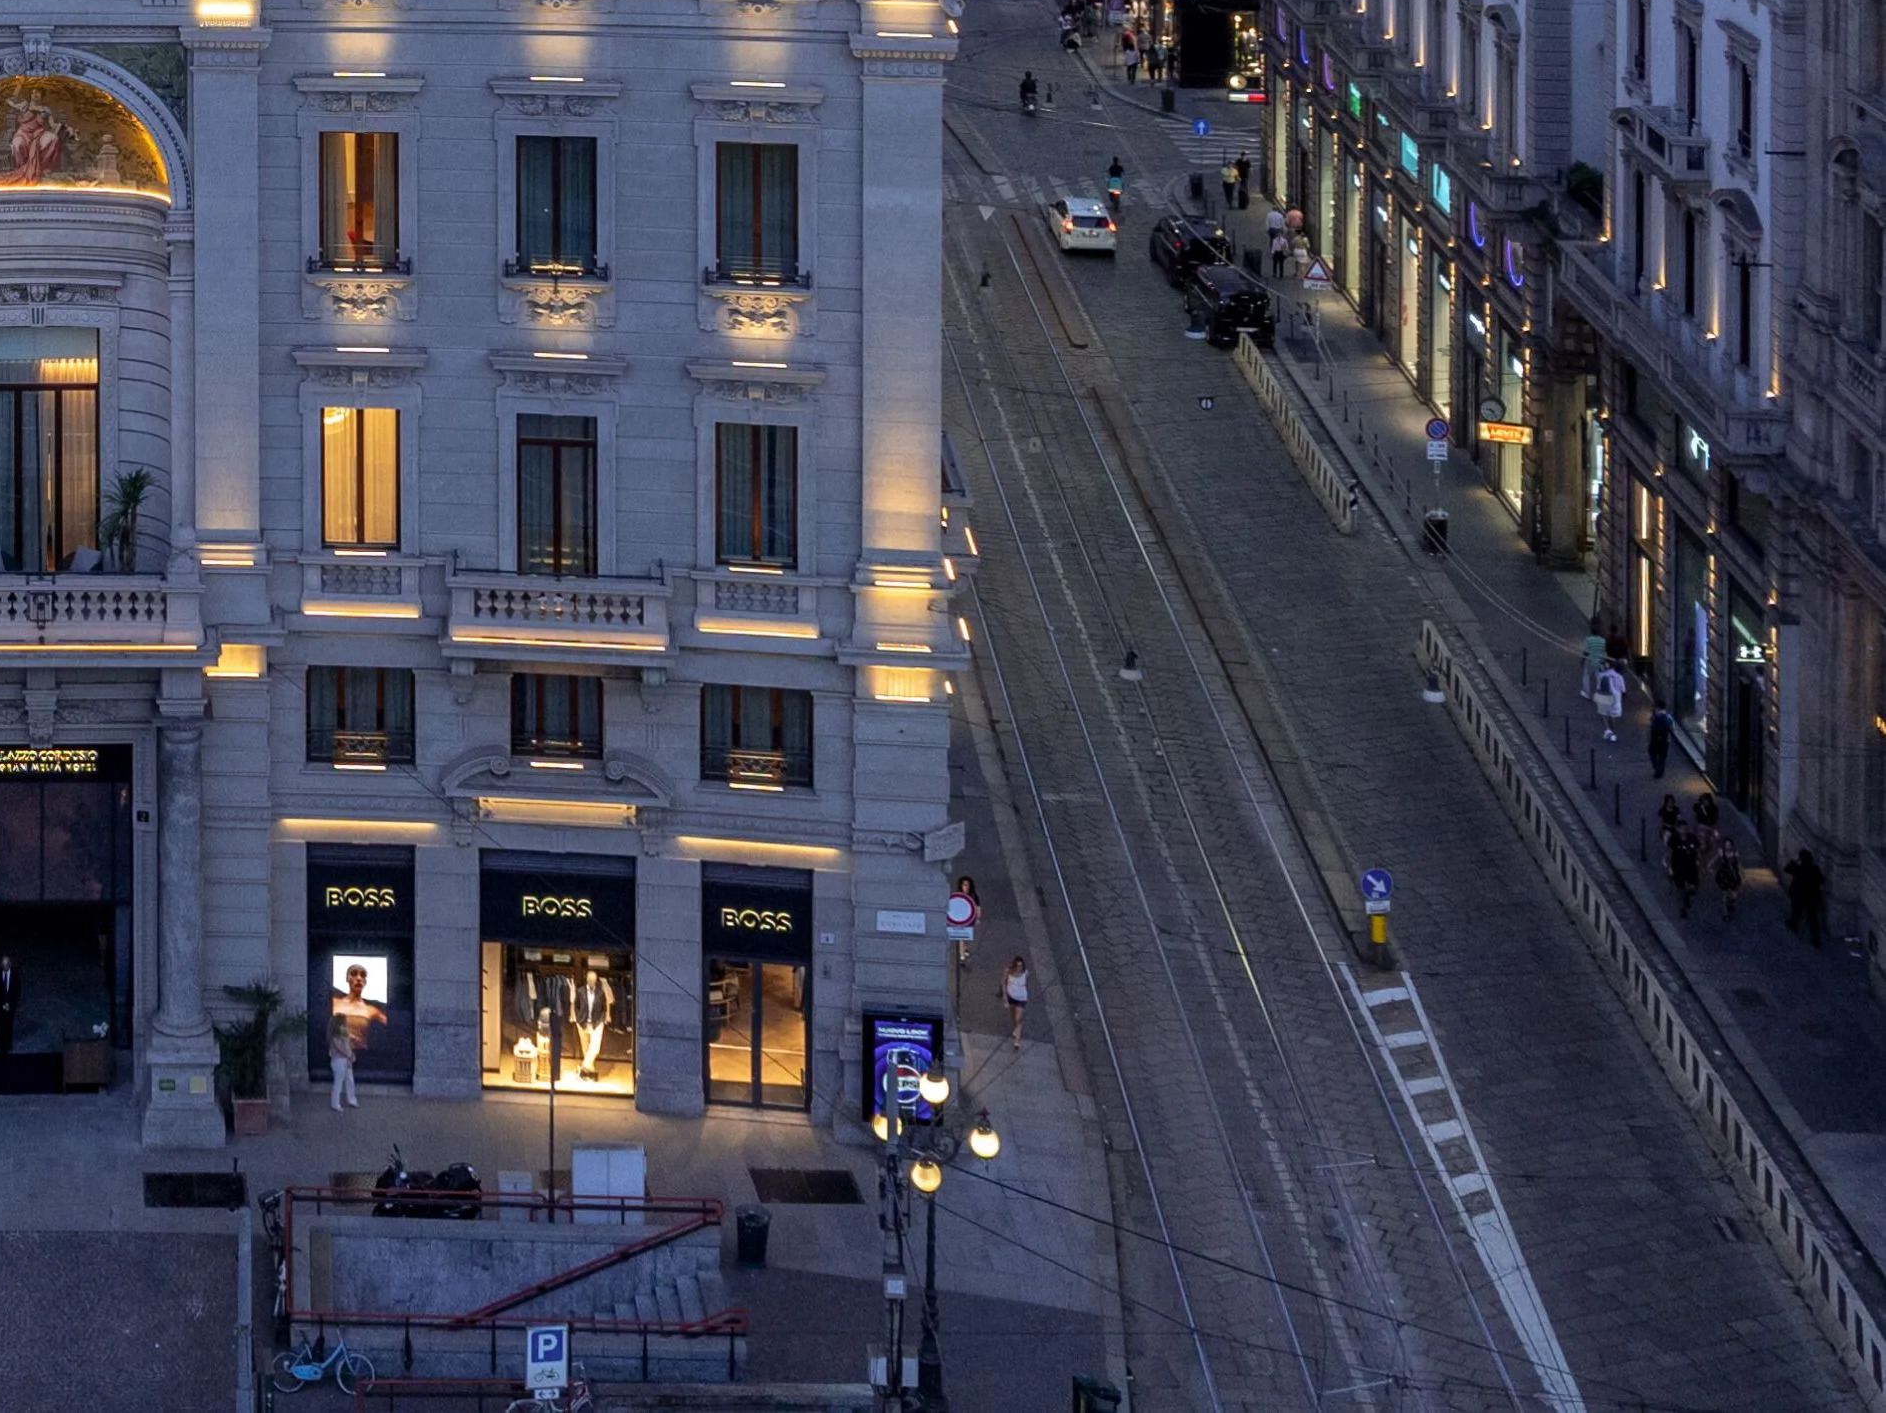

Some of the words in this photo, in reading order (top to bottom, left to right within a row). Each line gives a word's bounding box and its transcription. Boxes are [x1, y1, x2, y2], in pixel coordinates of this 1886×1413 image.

[326, 887, 396, 907] BOSS
[522, 896, 593, 918] BOSS
[720, 908, 793, 932] BOSS
[537, 1333, 558, 1360] P
